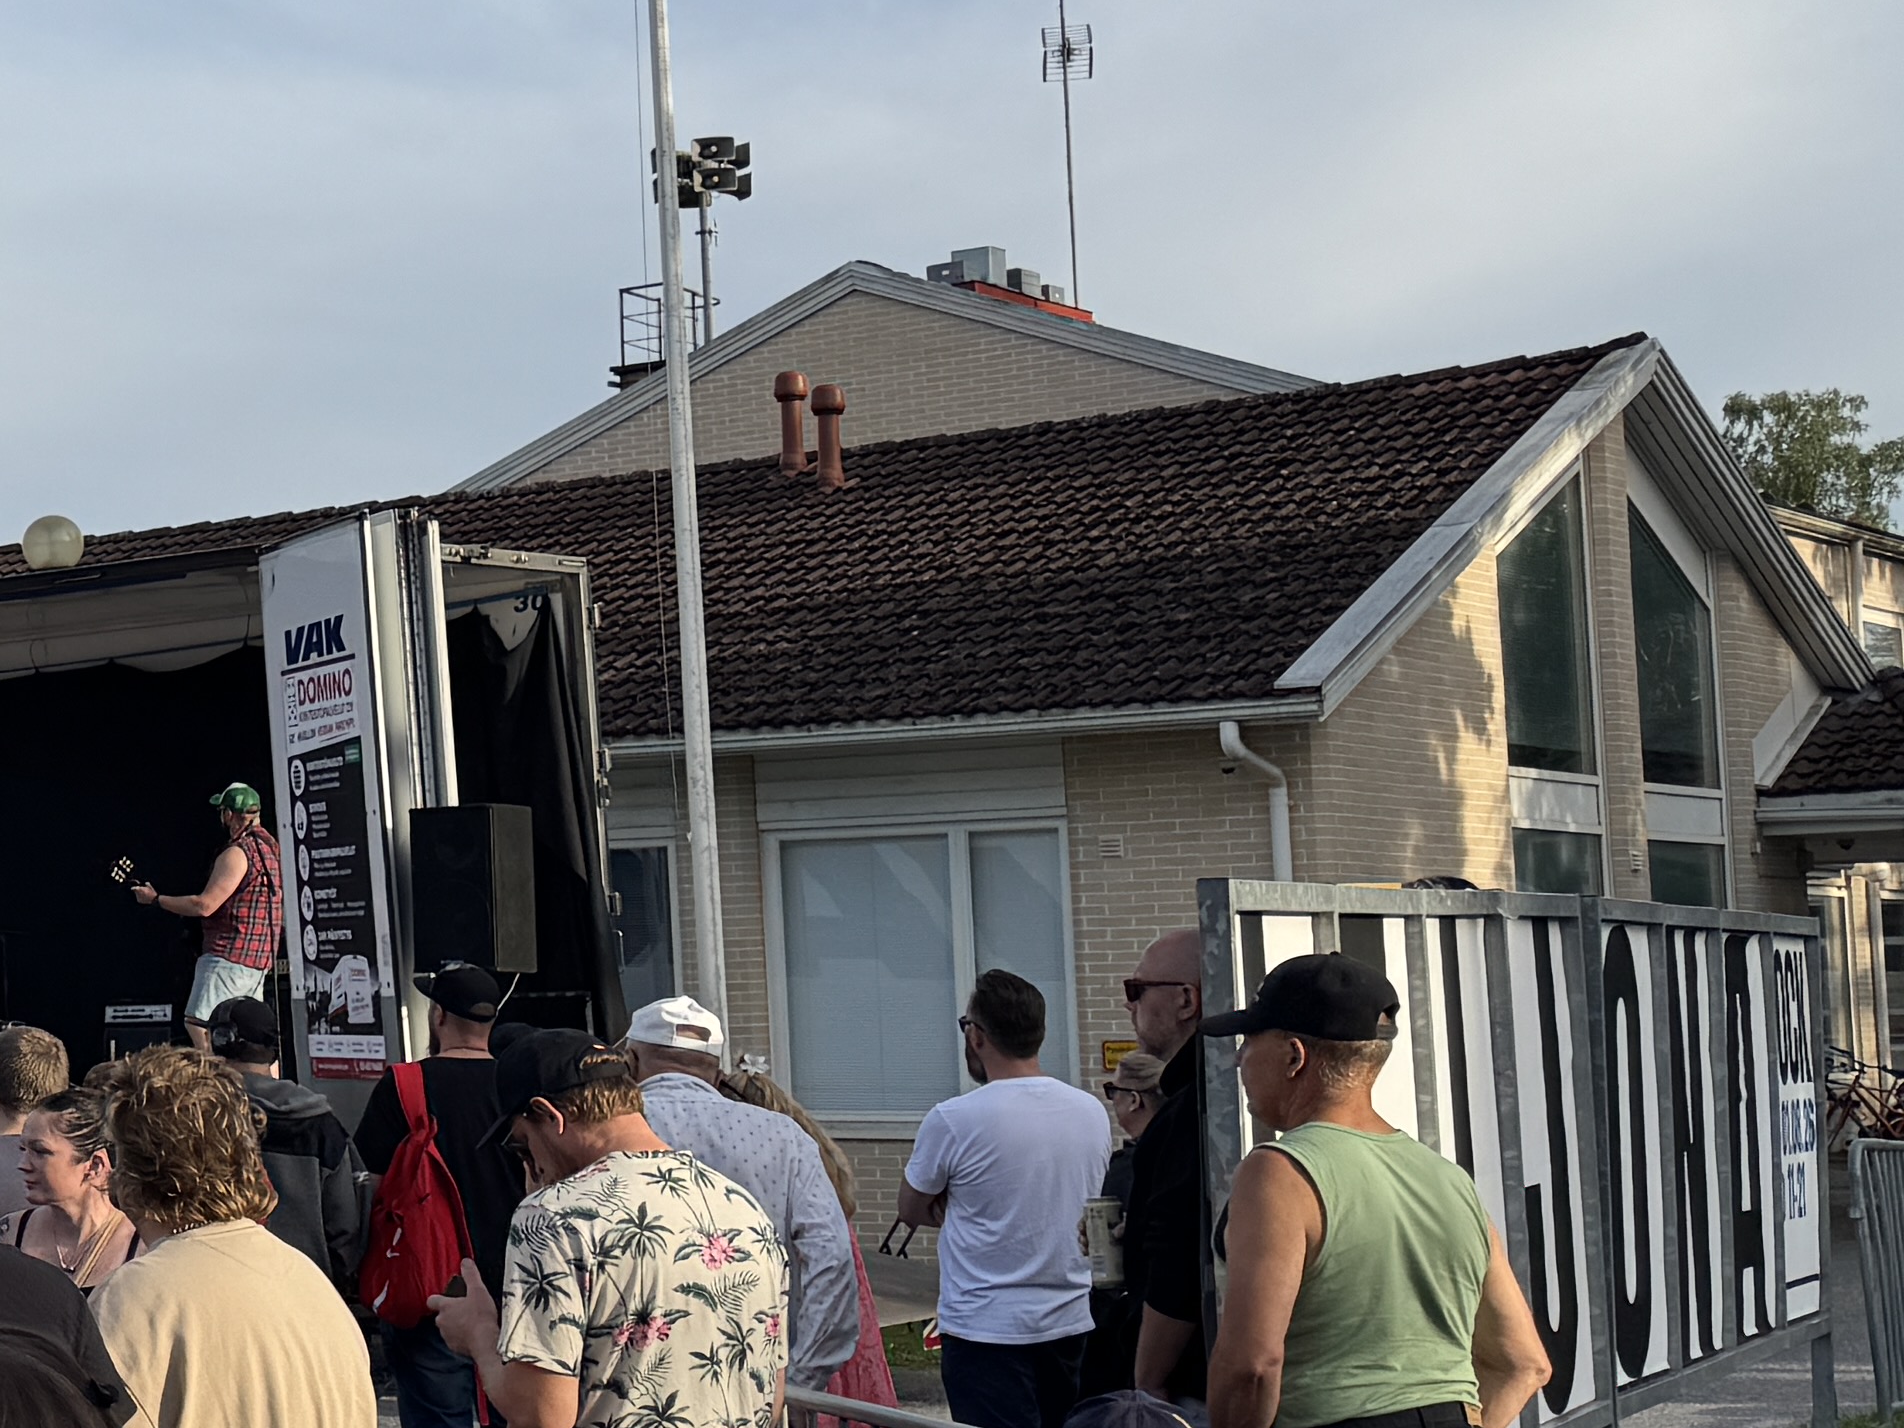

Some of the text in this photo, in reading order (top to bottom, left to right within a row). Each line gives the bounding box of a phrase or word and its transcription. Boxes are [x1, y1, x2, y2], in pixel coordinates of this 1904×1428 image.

[284, 614, 346, 666] VAK
[297, 668, 353, 707] DOMINO
[1773, 948, 1813, 1086] OCK
